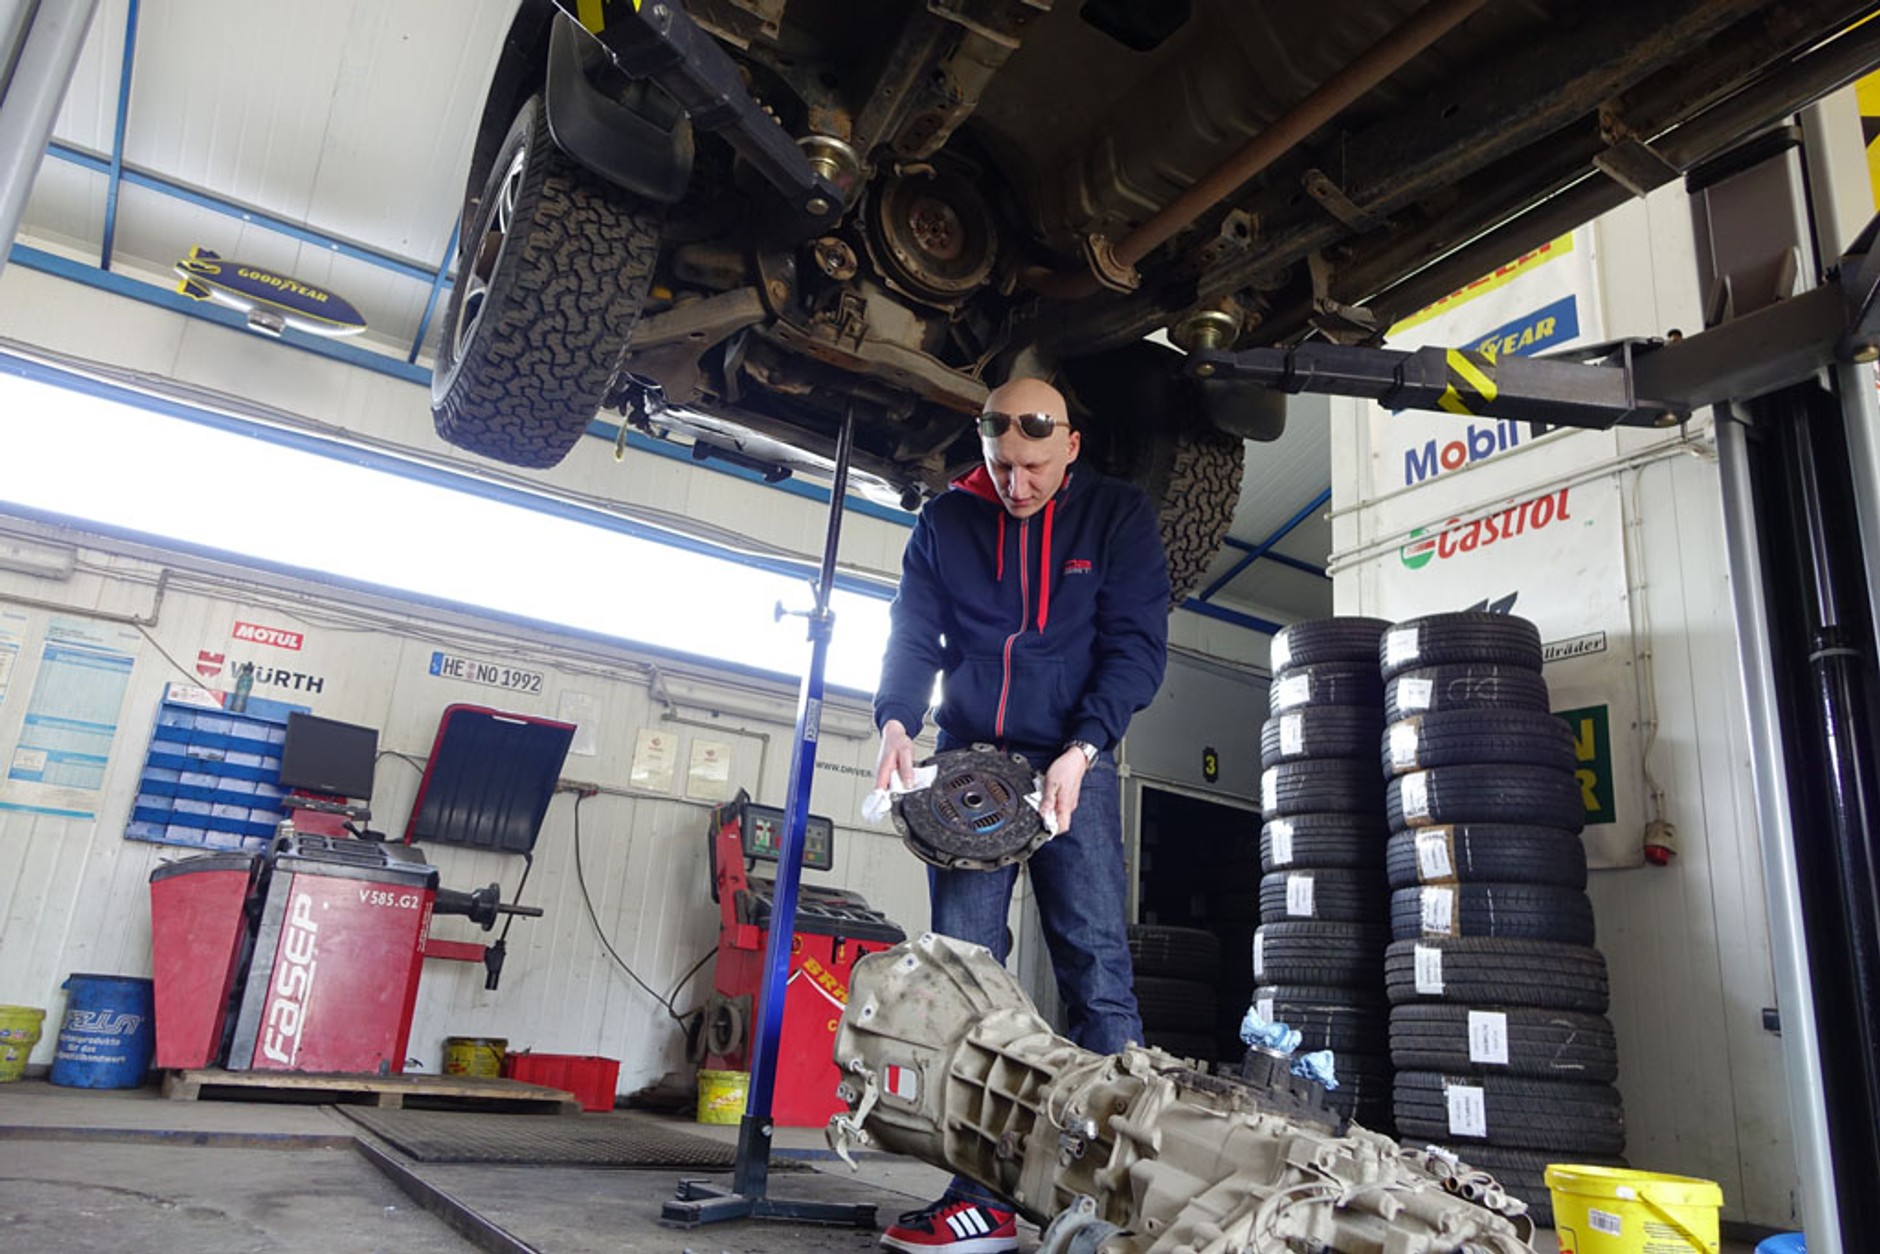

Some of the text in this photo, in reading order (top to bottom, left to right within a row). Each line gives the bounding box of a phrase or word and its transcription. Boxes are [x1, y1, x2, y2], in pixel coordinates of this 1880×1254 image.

[238, 268, 328, 302] GOODYEAR
[1404, 418, 1519, 486] Mobil
[1437, 487, 1571, 559] Castrol
[235, 624, 300, 648] MOTUL
[442, 658, 541, 692] HE NO 1992
[1205, 754, 1216, 775] 3
